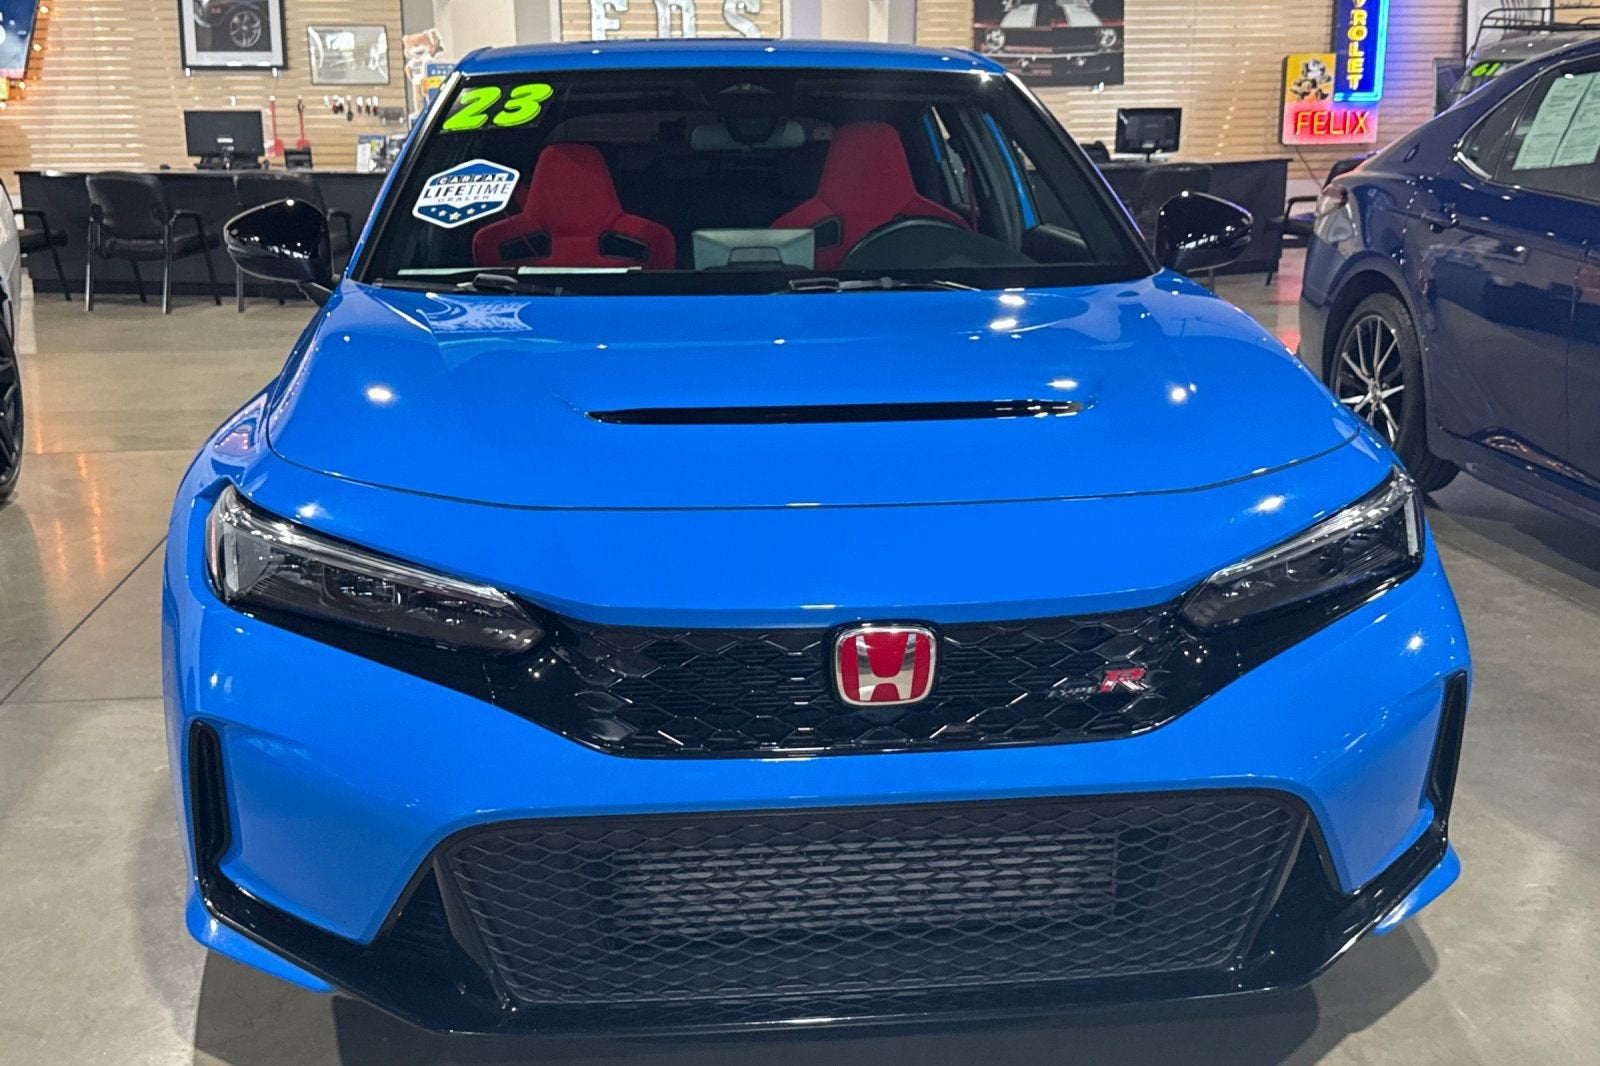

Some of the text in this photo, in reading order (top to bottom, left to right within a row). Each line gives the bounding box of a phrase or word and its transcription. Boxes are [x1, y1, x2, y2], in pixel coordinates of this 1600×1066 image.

[443, 83, 553, 130] 23
[1295, 111, 1369, 135] FELIX
[423, 183, 511, 199] LIFETIME
[437, 173, 508, 185] CARFAX
[1100, 668, 1148, 692] R
